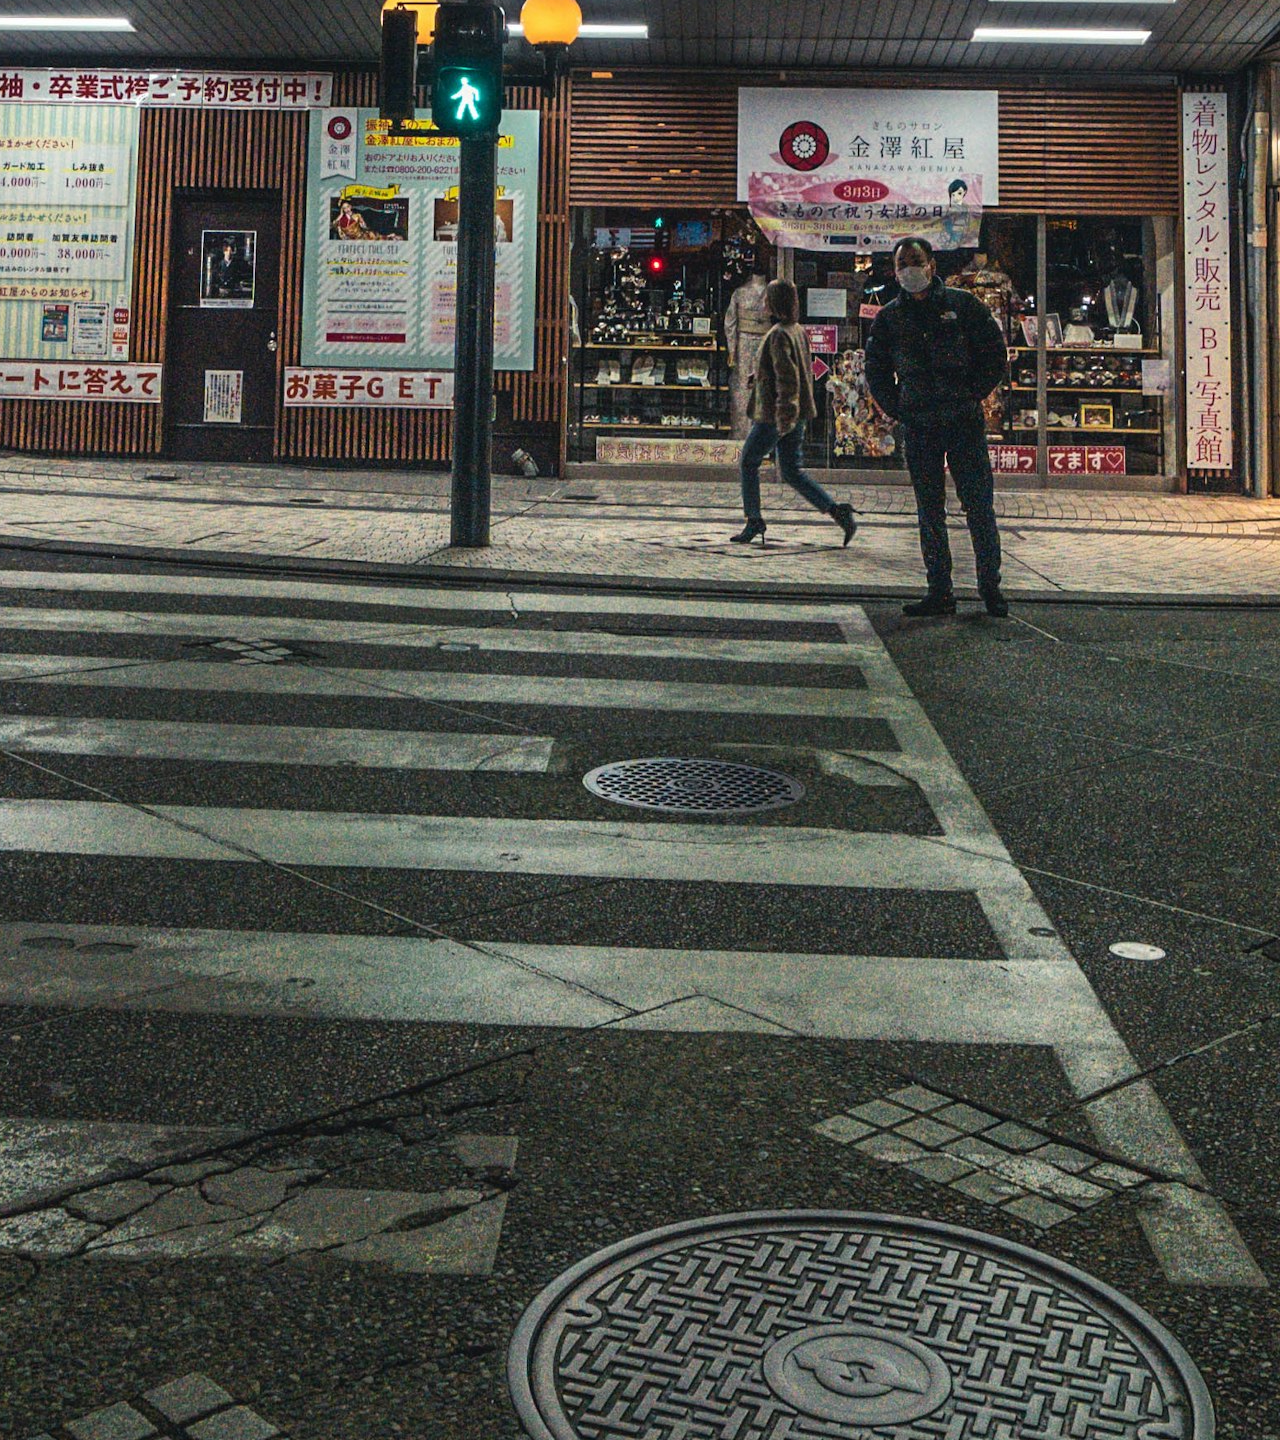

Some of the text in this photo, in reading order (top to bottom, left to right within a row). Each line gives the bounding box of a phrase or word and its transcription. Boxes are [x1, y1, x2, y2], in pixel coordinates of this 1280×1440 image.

[871, 120, 944, 132] きものサロン
[847, 134, 966, 161] 金澤紅屋
[1, 161, 46, 171] ガード加工
[70, 162, 106, 172] しみ抜き
[847, 164, 913, 173] KANAZAWA
[841, 184, 882, 199] 3月3日
[776, 203, 945, 221] きもので祝う女性の日
[5, 232, 35, 242] 訪問着
[1191, 98, 1223, 466] 着物レンタル・販売 B1写真館
